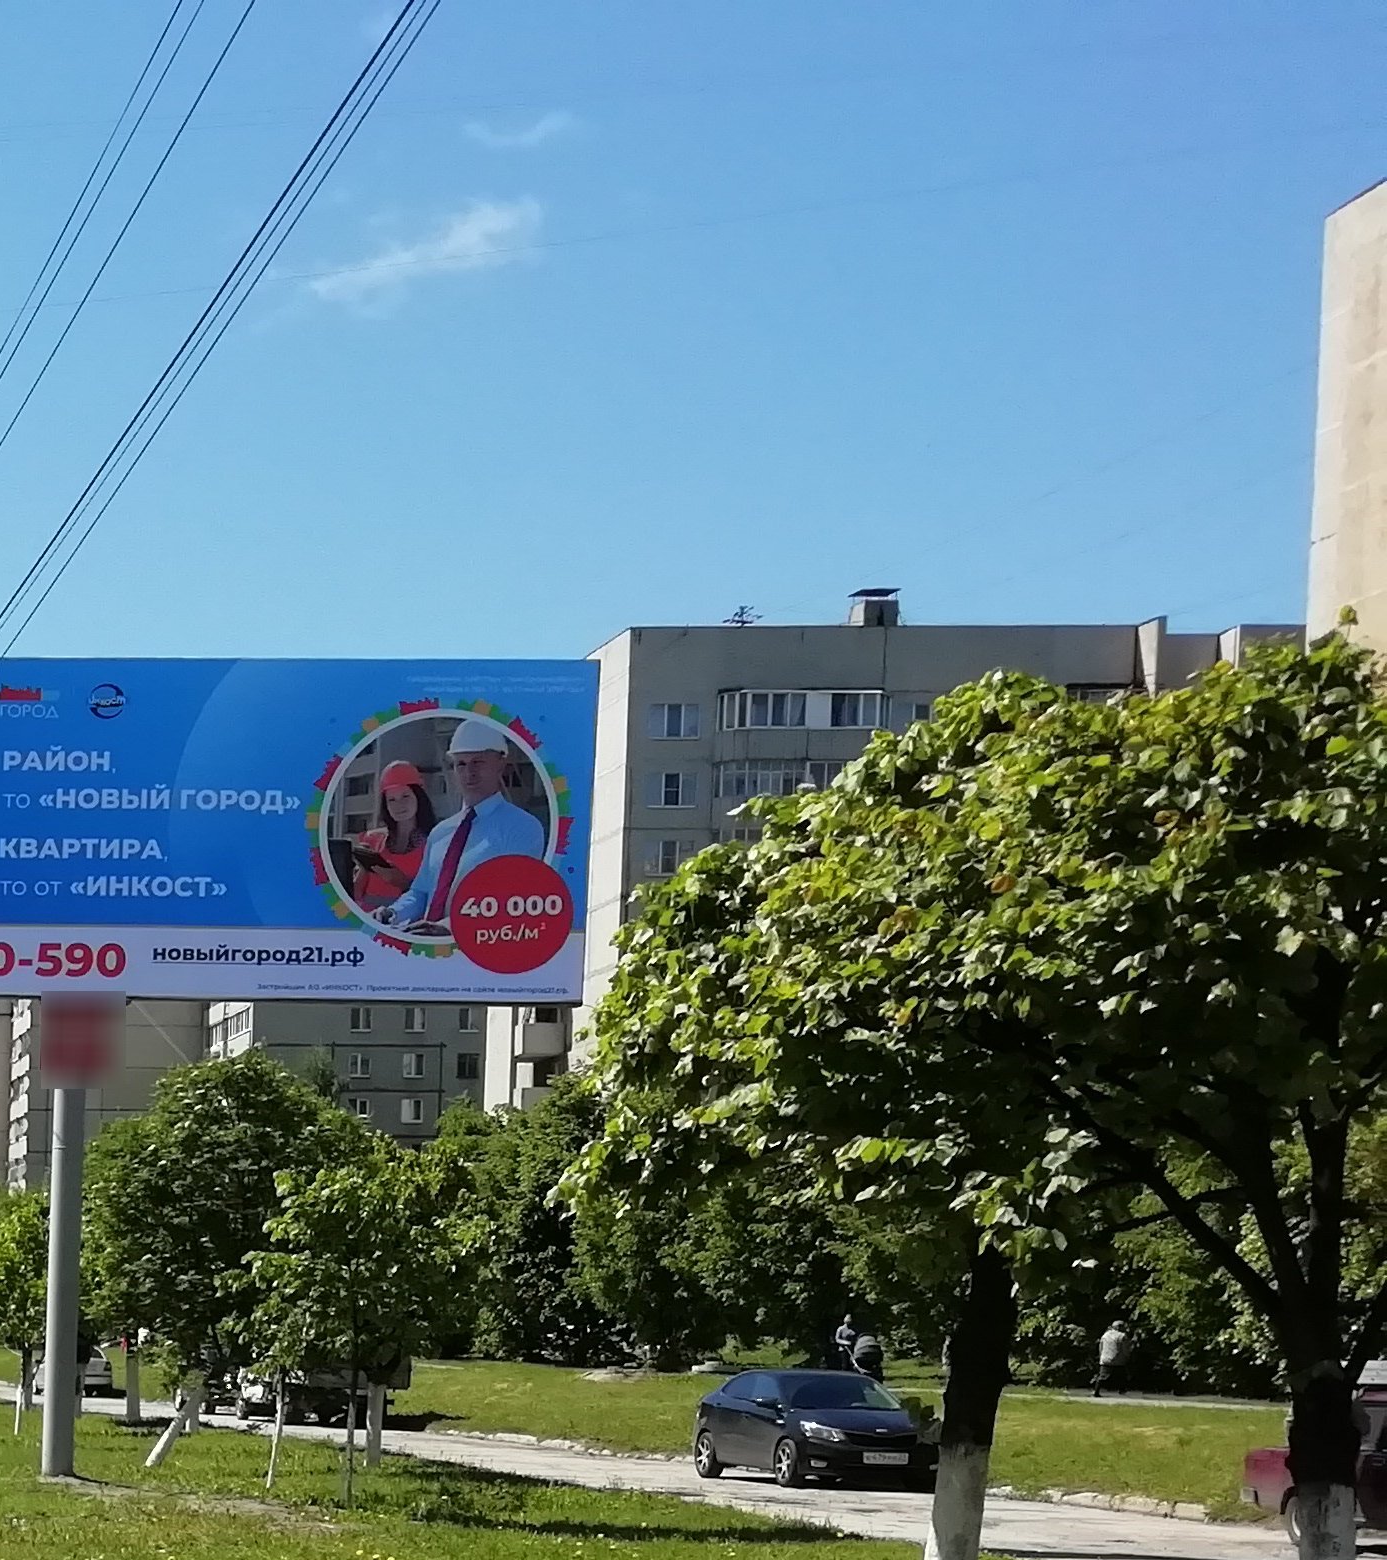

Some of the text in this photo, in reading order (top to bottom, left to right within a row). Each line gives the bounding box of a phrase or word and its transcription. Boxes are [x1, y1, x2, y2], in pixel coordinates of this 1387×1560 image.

[0, 704, 59, 719] ГОРОД
[2, 745, 116, 774] РАЙОН,
[3, 784, 302, 815] то «НОВЫЙ ГОРОД»
[0, 875, 228, 898] то от «ИНКОСТ»
[459, 894, 564, 918] 40 000
[151, 944, 365, 967] новыйгород21.рф
